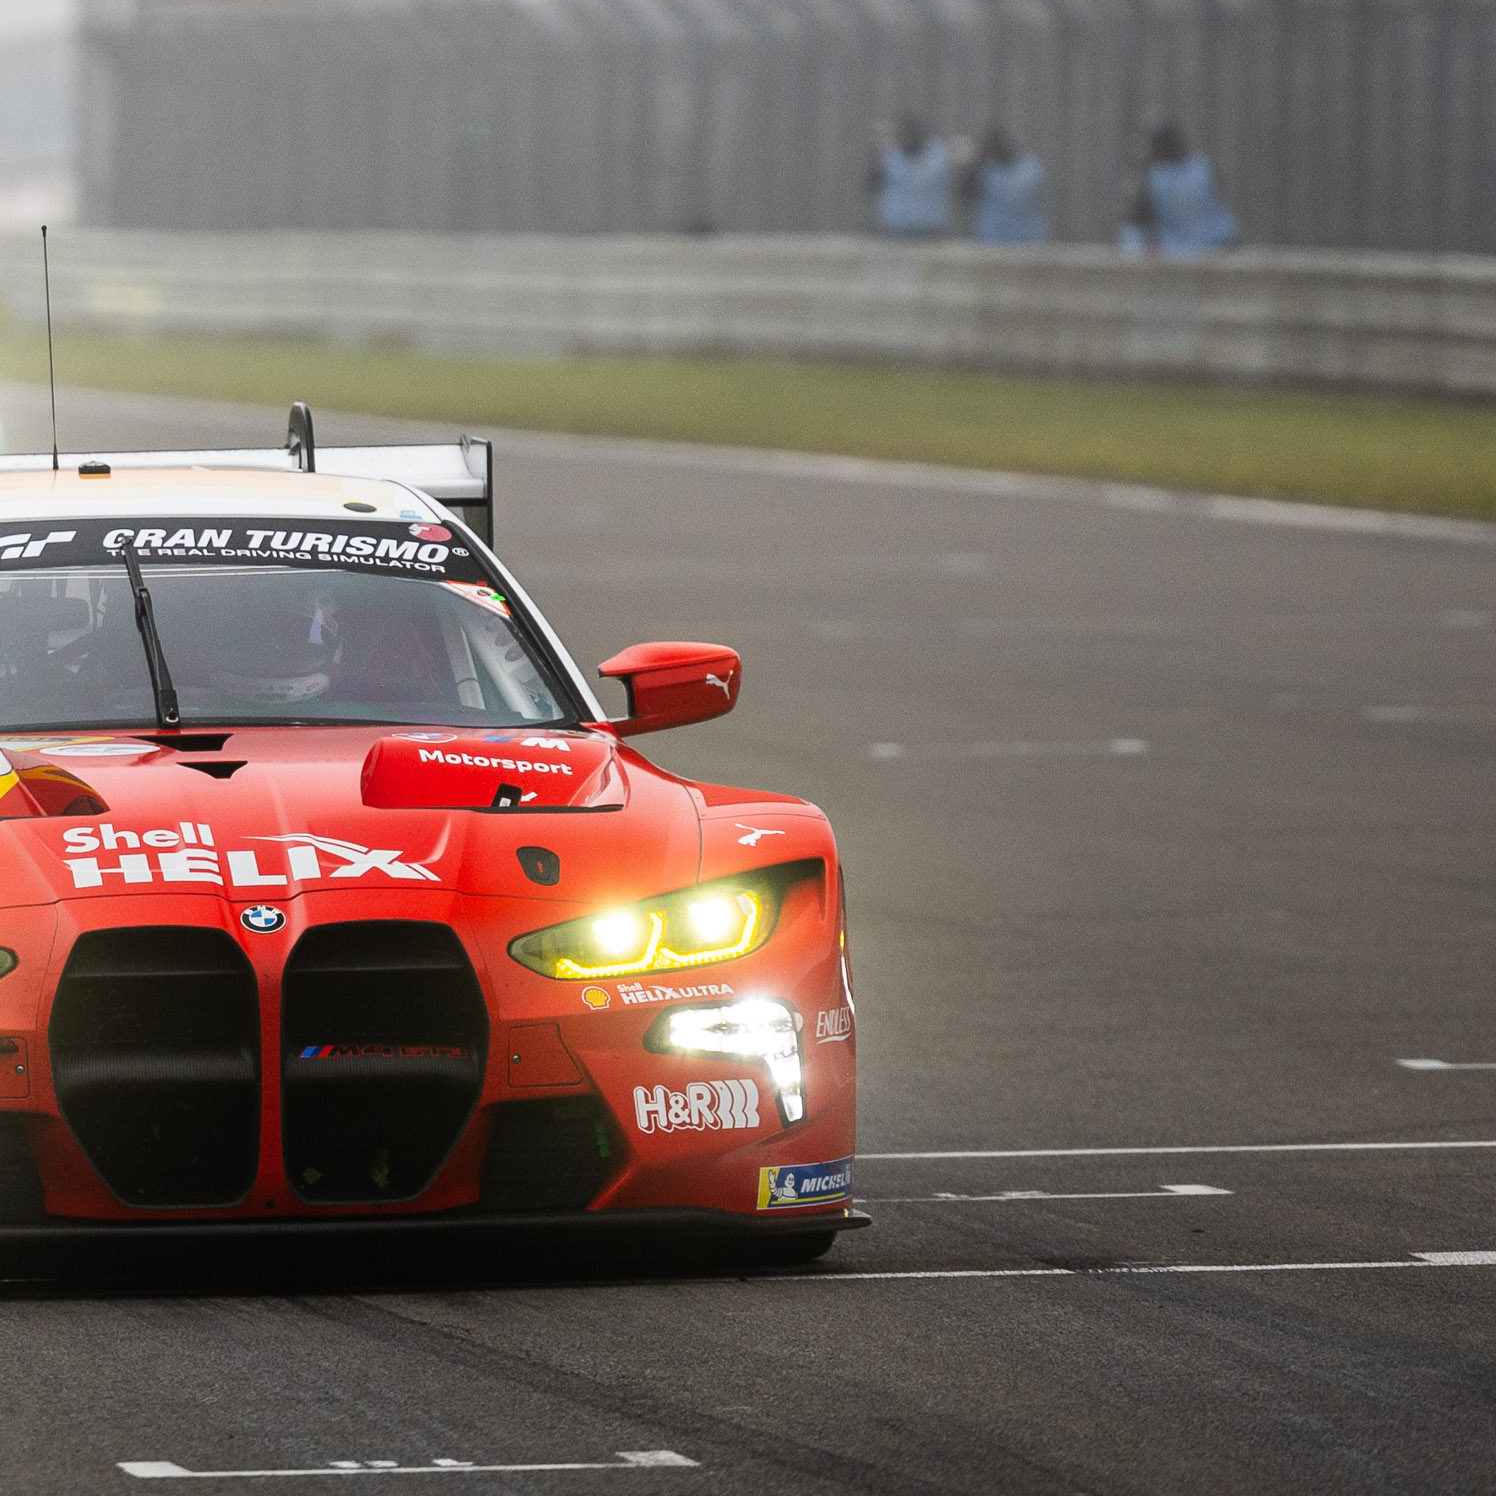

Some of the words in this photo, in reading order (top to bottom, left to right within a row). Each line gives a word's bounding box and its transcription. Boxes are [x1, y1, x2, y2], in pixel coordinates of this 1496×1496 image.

[102, 529, 233, 549] GRAN
[106, 548, 151, 557] TE
[157, 548, 216, 557] REAL
[221, 548, 311, 560] DRIVING
[318, 552, 446, 574] SIMULATOR
[418, 749, 574, 776] Motorsport
[63, 822, 214, 853] Shell
[62, 833, 442, 889] HELIX
[617, 982, 643, 994] Shell
[619, 986, 680, 1005] HELIX
[678, 983, 735, 999] ULTRA
[633, 1081, 721, 1134] H&R
